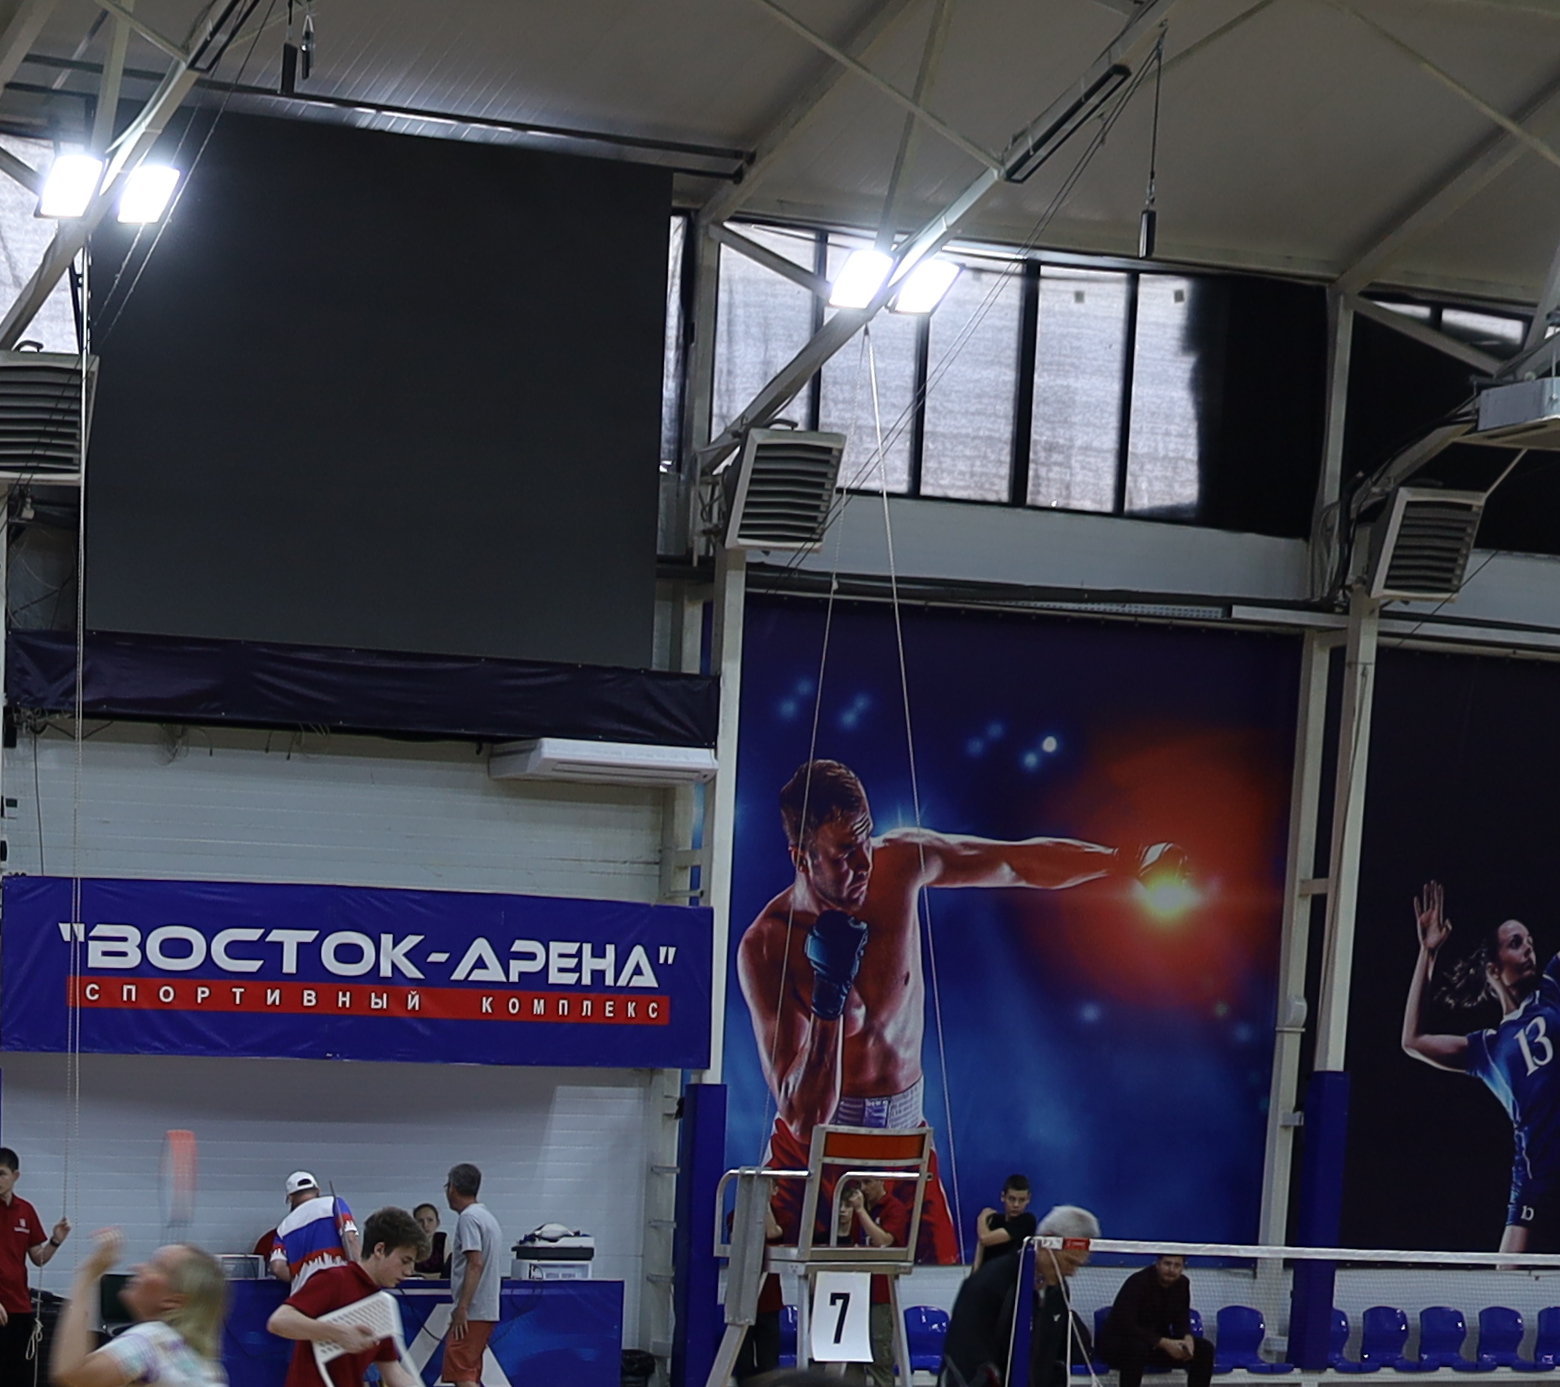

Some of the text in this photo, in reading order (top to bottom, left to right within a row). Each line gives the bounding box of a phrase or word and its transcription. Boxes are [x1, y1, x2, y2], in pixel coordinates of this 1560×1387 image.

[58, 921, 678, 988] "ВОСТОК-АРЕНА"
[84, 983, 660, 1019] СПОРТИВНЫЙ КОМПЛЕКС
[1514, 1015, 1554, 1077] 13
[829, 1292, 851, 1345] 7
